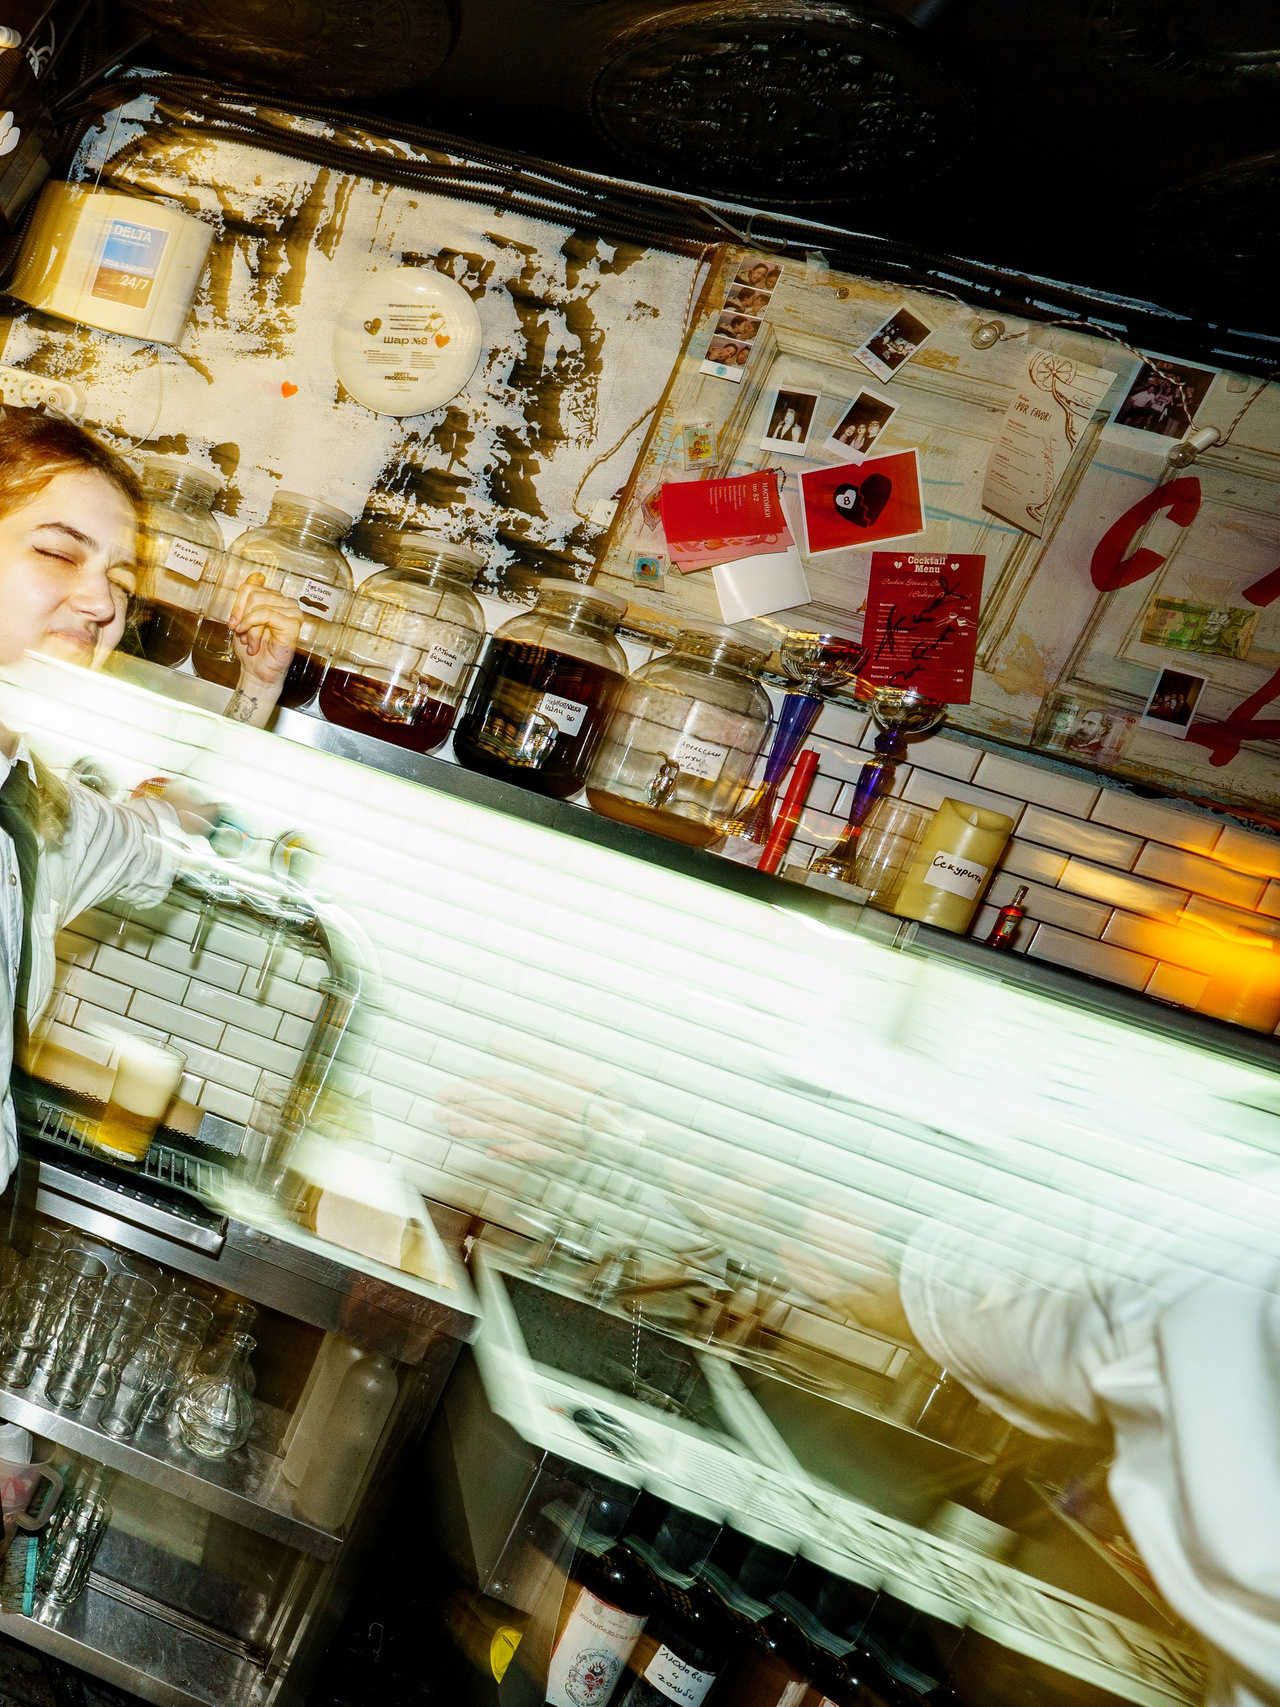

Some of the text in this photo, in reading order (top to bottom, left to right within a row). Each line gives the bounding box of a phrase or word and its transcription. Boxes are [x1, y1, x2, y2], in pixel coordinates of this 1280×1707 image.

[114, 224, 152, 243] DELTA
[104, 258, 120, 268] ПОД
[120, 274, 150, 291] 24/7
[383, 336, 410, 347] Шар
[762, 482, 771, 518] НАСТОЙКИ
[843, 496, 851, 506] 8
[907, 556, 946, 566] Cocktail
[914, 564, 941, 574] Menu
[932, 855, 983, 885] Секурити
